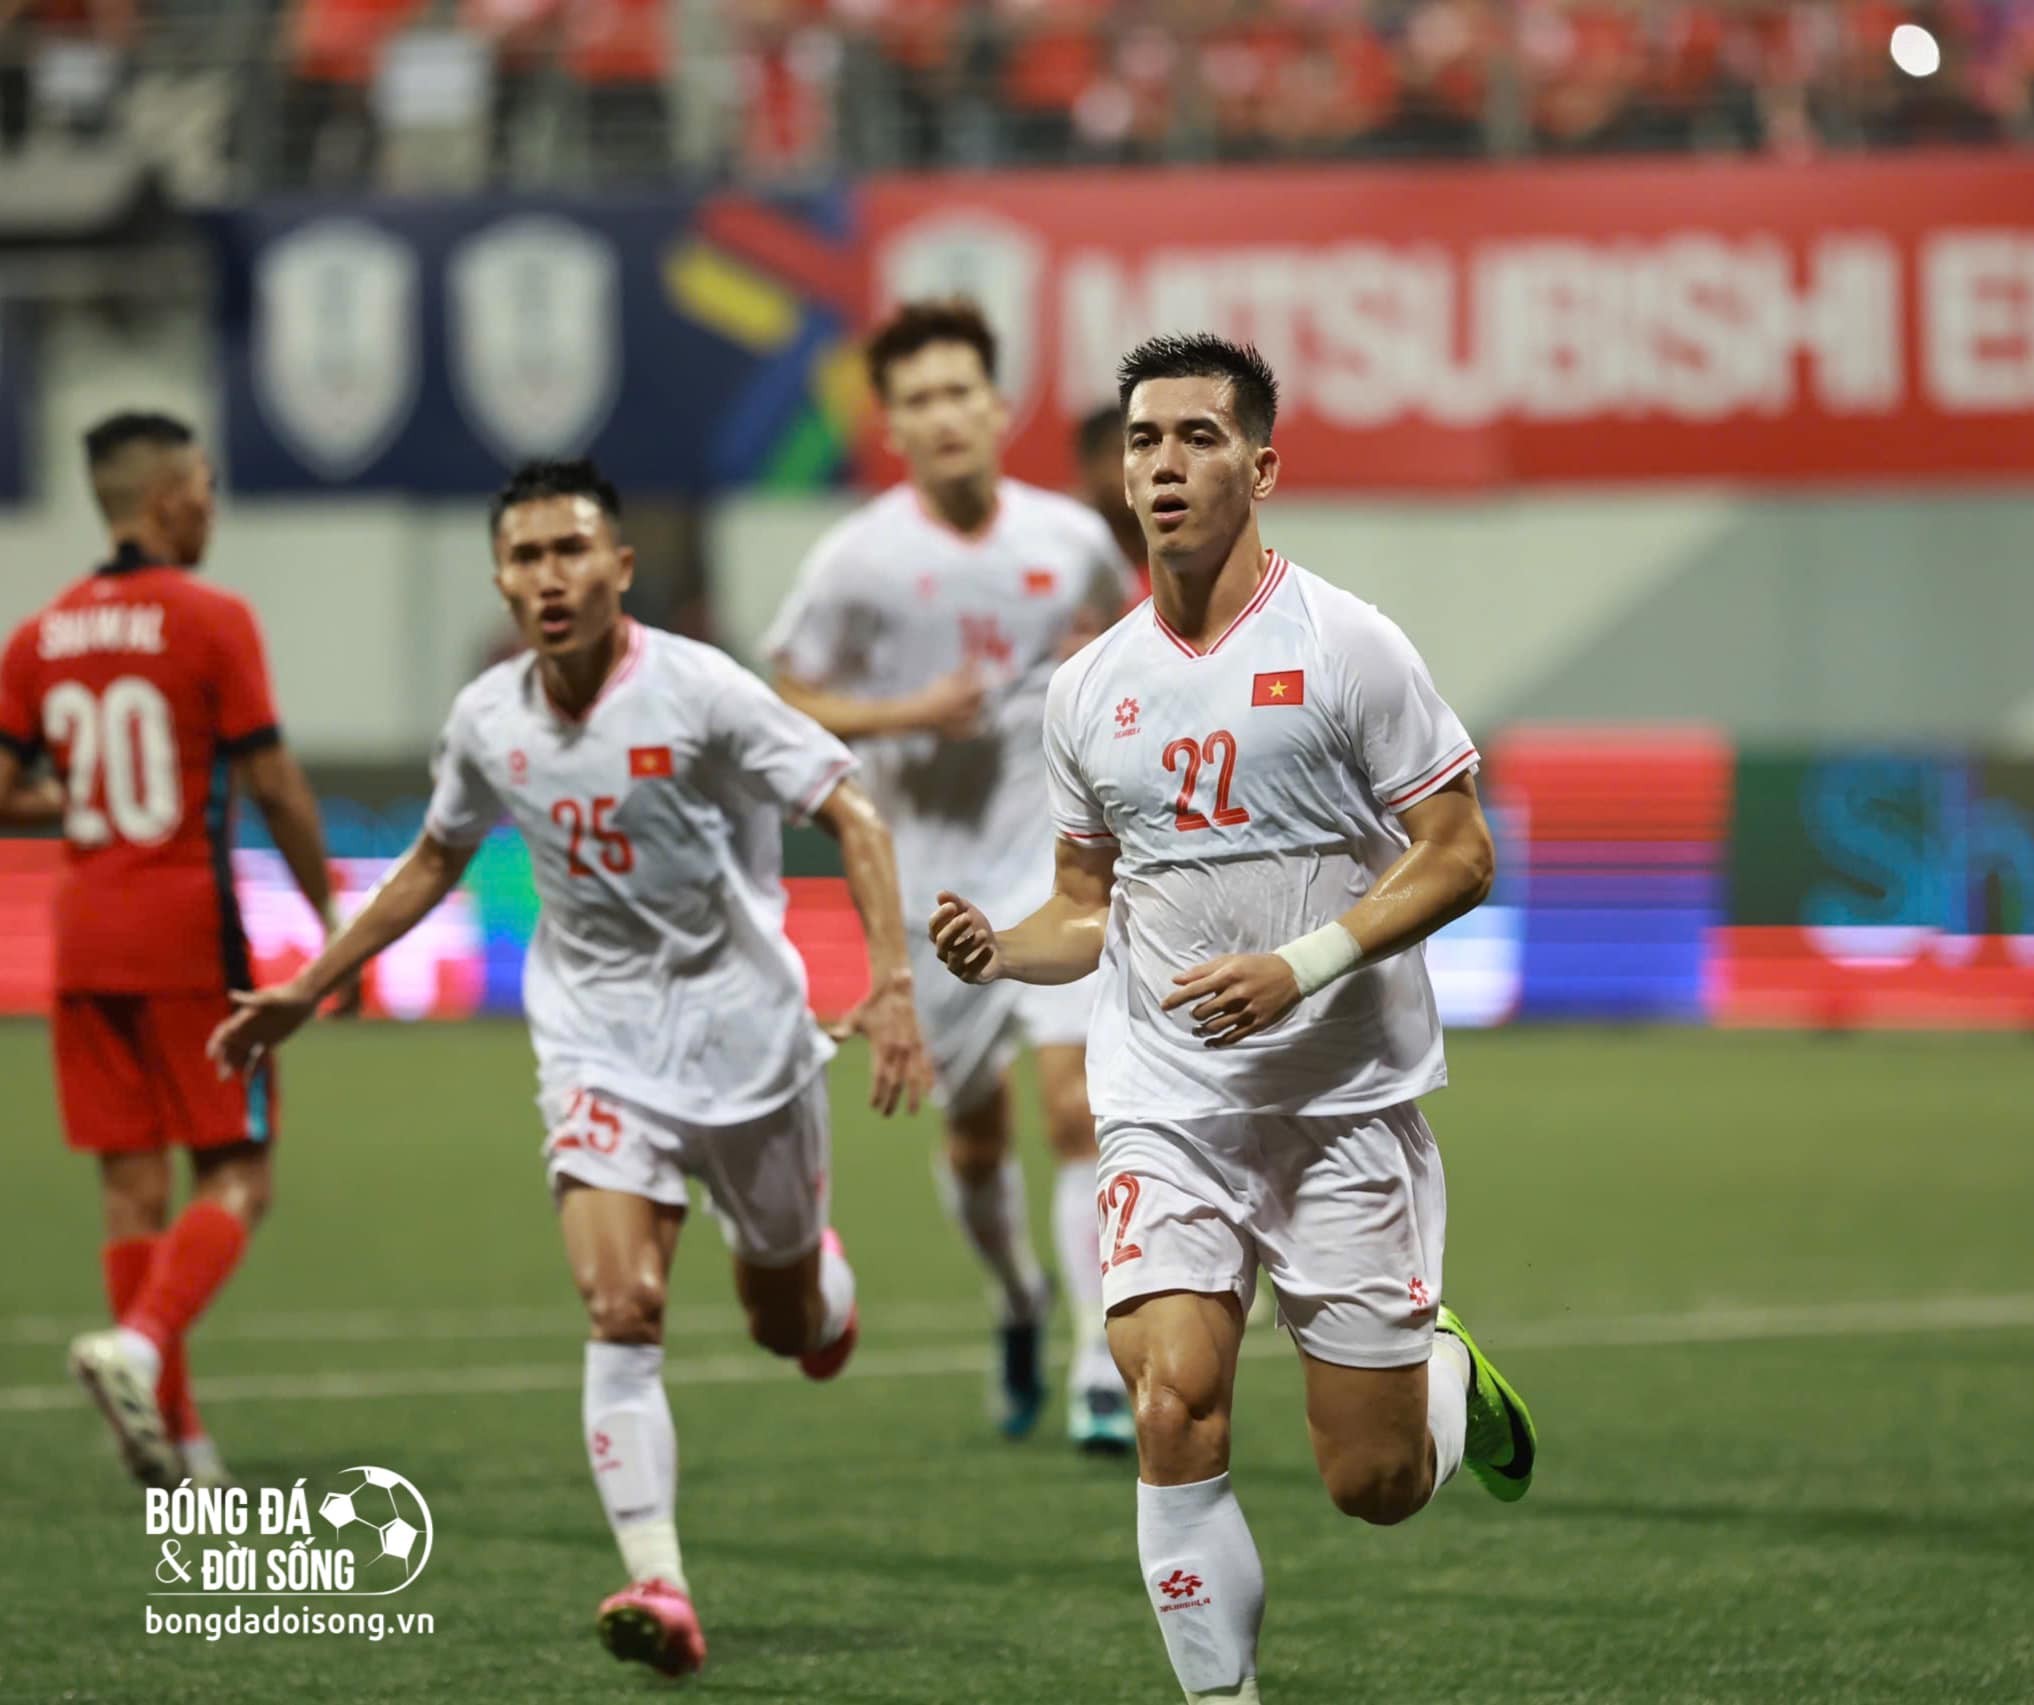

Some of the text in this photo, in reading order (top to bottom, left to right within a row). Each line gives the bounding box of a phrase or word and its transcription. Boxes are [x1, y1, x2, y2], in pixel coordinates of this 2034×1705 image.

[1064, 233, 1899, 424] MITSUBISHI
[43, 675, 181, 846] 20
[1162, 729, 1250, 831] 22
[551, 795, 635, 877] 25
